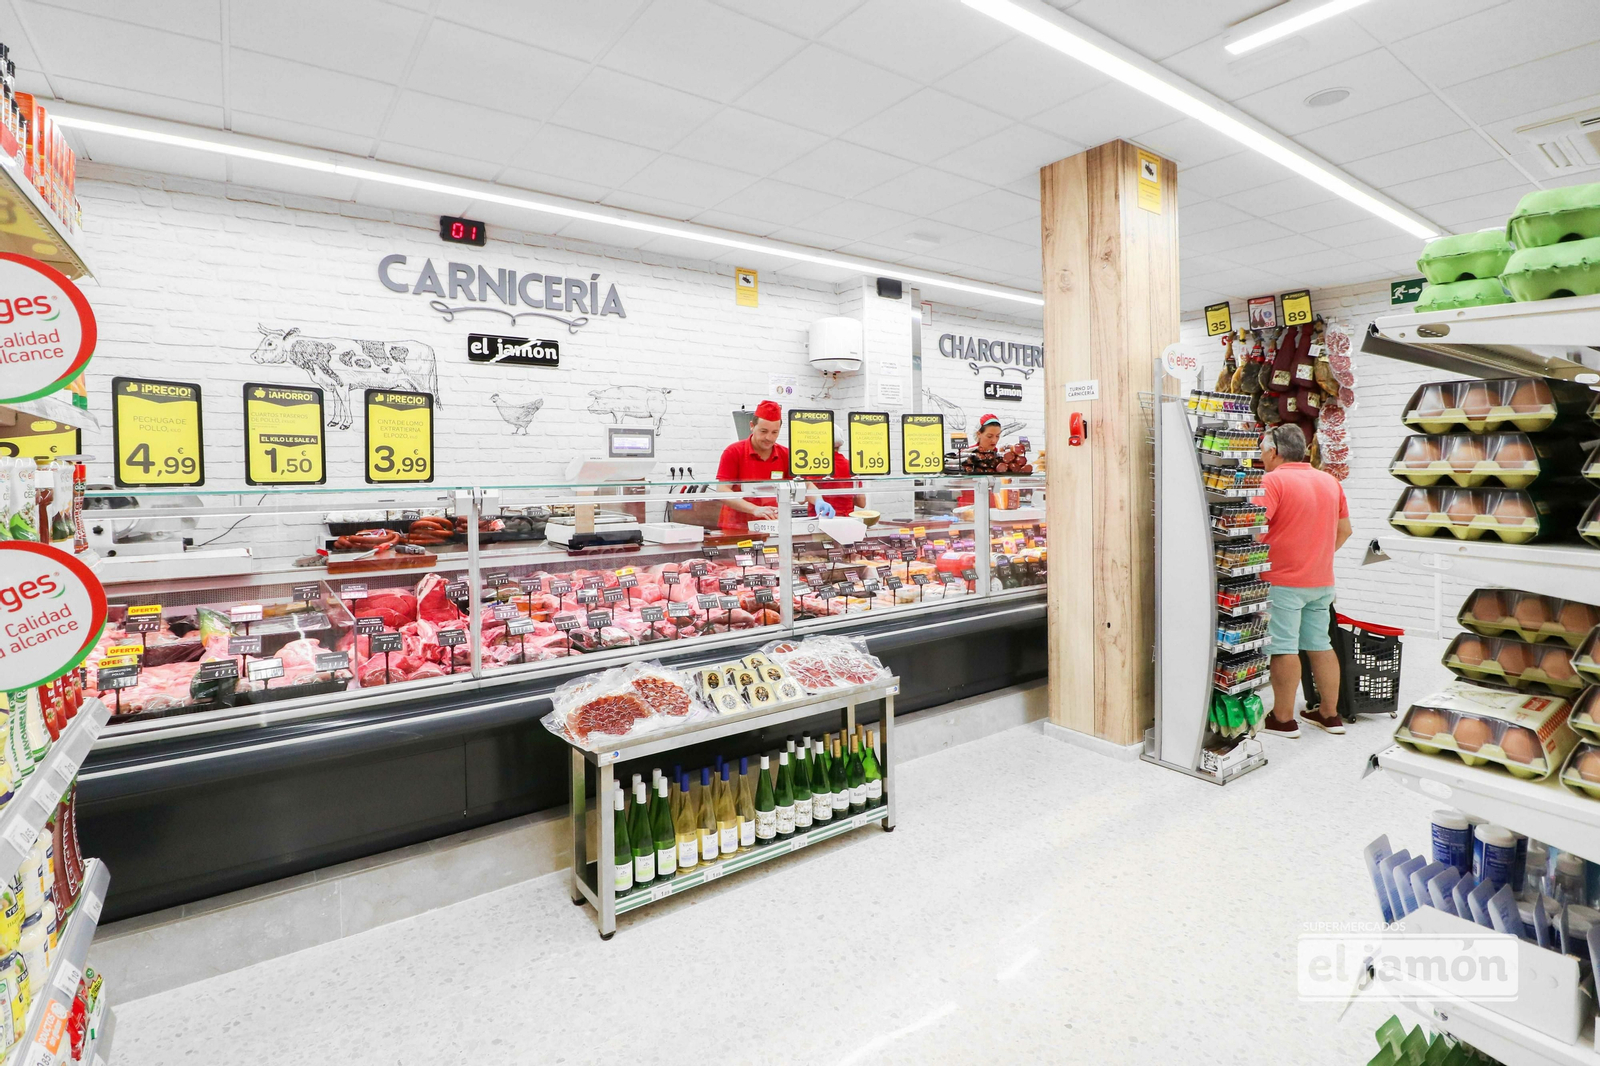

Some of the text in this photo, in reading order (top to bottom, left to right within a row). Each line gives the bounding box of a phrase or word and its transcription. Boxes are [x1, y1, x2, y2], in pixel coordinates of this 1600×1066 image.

[452, 222, 476, 240] 01
[378, 254, 626, 318] CARNICERÍA
[1288, 310, 1306, 322] 89
[1211, 322, 1226, 332] 35
[0, 328, 60, 348] alidad
[0, 347, 64, 364] lcance
[470, 338, 558, 362] el jamón
[1176, 355, 1196, 370] eliges
[142, 384, 191, 397] ¡PRECIO!
[268, 392, 313, 401] ¡AHORRO!
[386, 394, 425, 404] ¡PRECIO!
[986, 385, 1022, 397] el jamón
[133, 416, 174, 424] PECHUGA
[139, 424, 169, 432] POLLO,
[126, 443, 196, 477] 4,99
[264, 448, 312, 475] 1,50
[374, 446, 427, 474] 3,99
[795, 449, 830, 470] 3,99
[856, 450, 884, 470] 1,99
[908, 450, 940, 468] 2,99
[4, 603, 72, 638] Calidad
[10, 620, 79, 653] alcance
[101, 658, 134, 666] OFERTA
